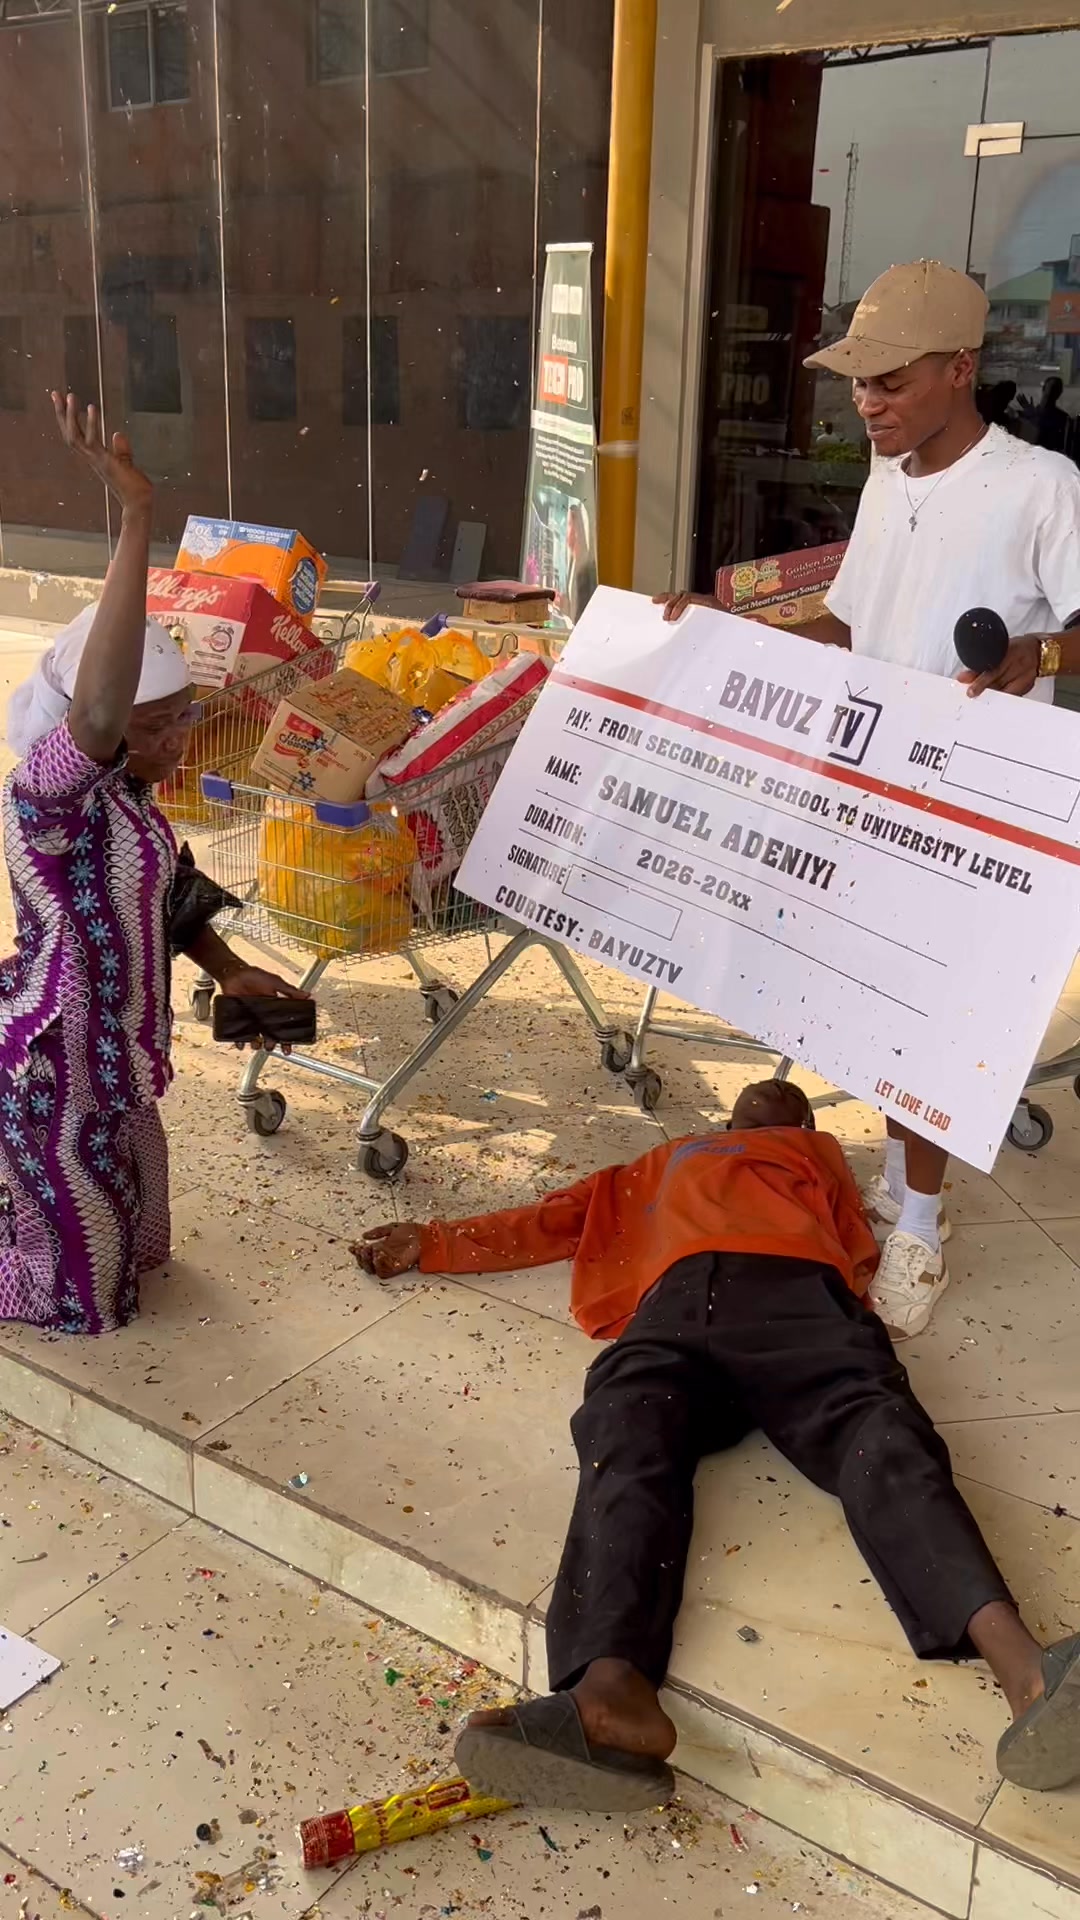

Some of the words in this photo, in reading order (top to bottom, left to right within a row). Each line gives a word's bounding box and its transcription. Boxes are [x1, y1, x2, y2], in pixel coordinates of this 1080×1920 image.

[730, 604, 750, 613] Goat
[750, 598, 771, 608] Meat
[771, 590, 799, 604] Pepper
[800, 583, 820, 596] Soup
[719, 670, 823, 736] BAYUZ
[826, 703, 866, 749] TV
[908, 740, 948, 772] DATE:
[524, 804, 587, 846] DURATION:
[544, 755, 582, 786] NAME:
[598, 775, 713, 841] SAMUEL
[721, 823, 838, 890] ADENIYI
[565, 707, 592, 732] PAY:
[598, 717, 643, 747] FROM
[645, 733, 759, 788] SECONDARY
[760, 776, 831, 817] SCHOOL
[837, 801, 858, 826] TO
[861, 812, 967, 867] UNIVERSITY
[968, 852, 1033, 895] LEVEL
[495, 885, 584, 943] COURTESY:
[588, 929, 684, 985] BAYUZTV
[874, 1077, 895, 1099] LET
[895, 1088, 923, 1116] LOVE
[923, 1105, 951, 1131] LEAD
